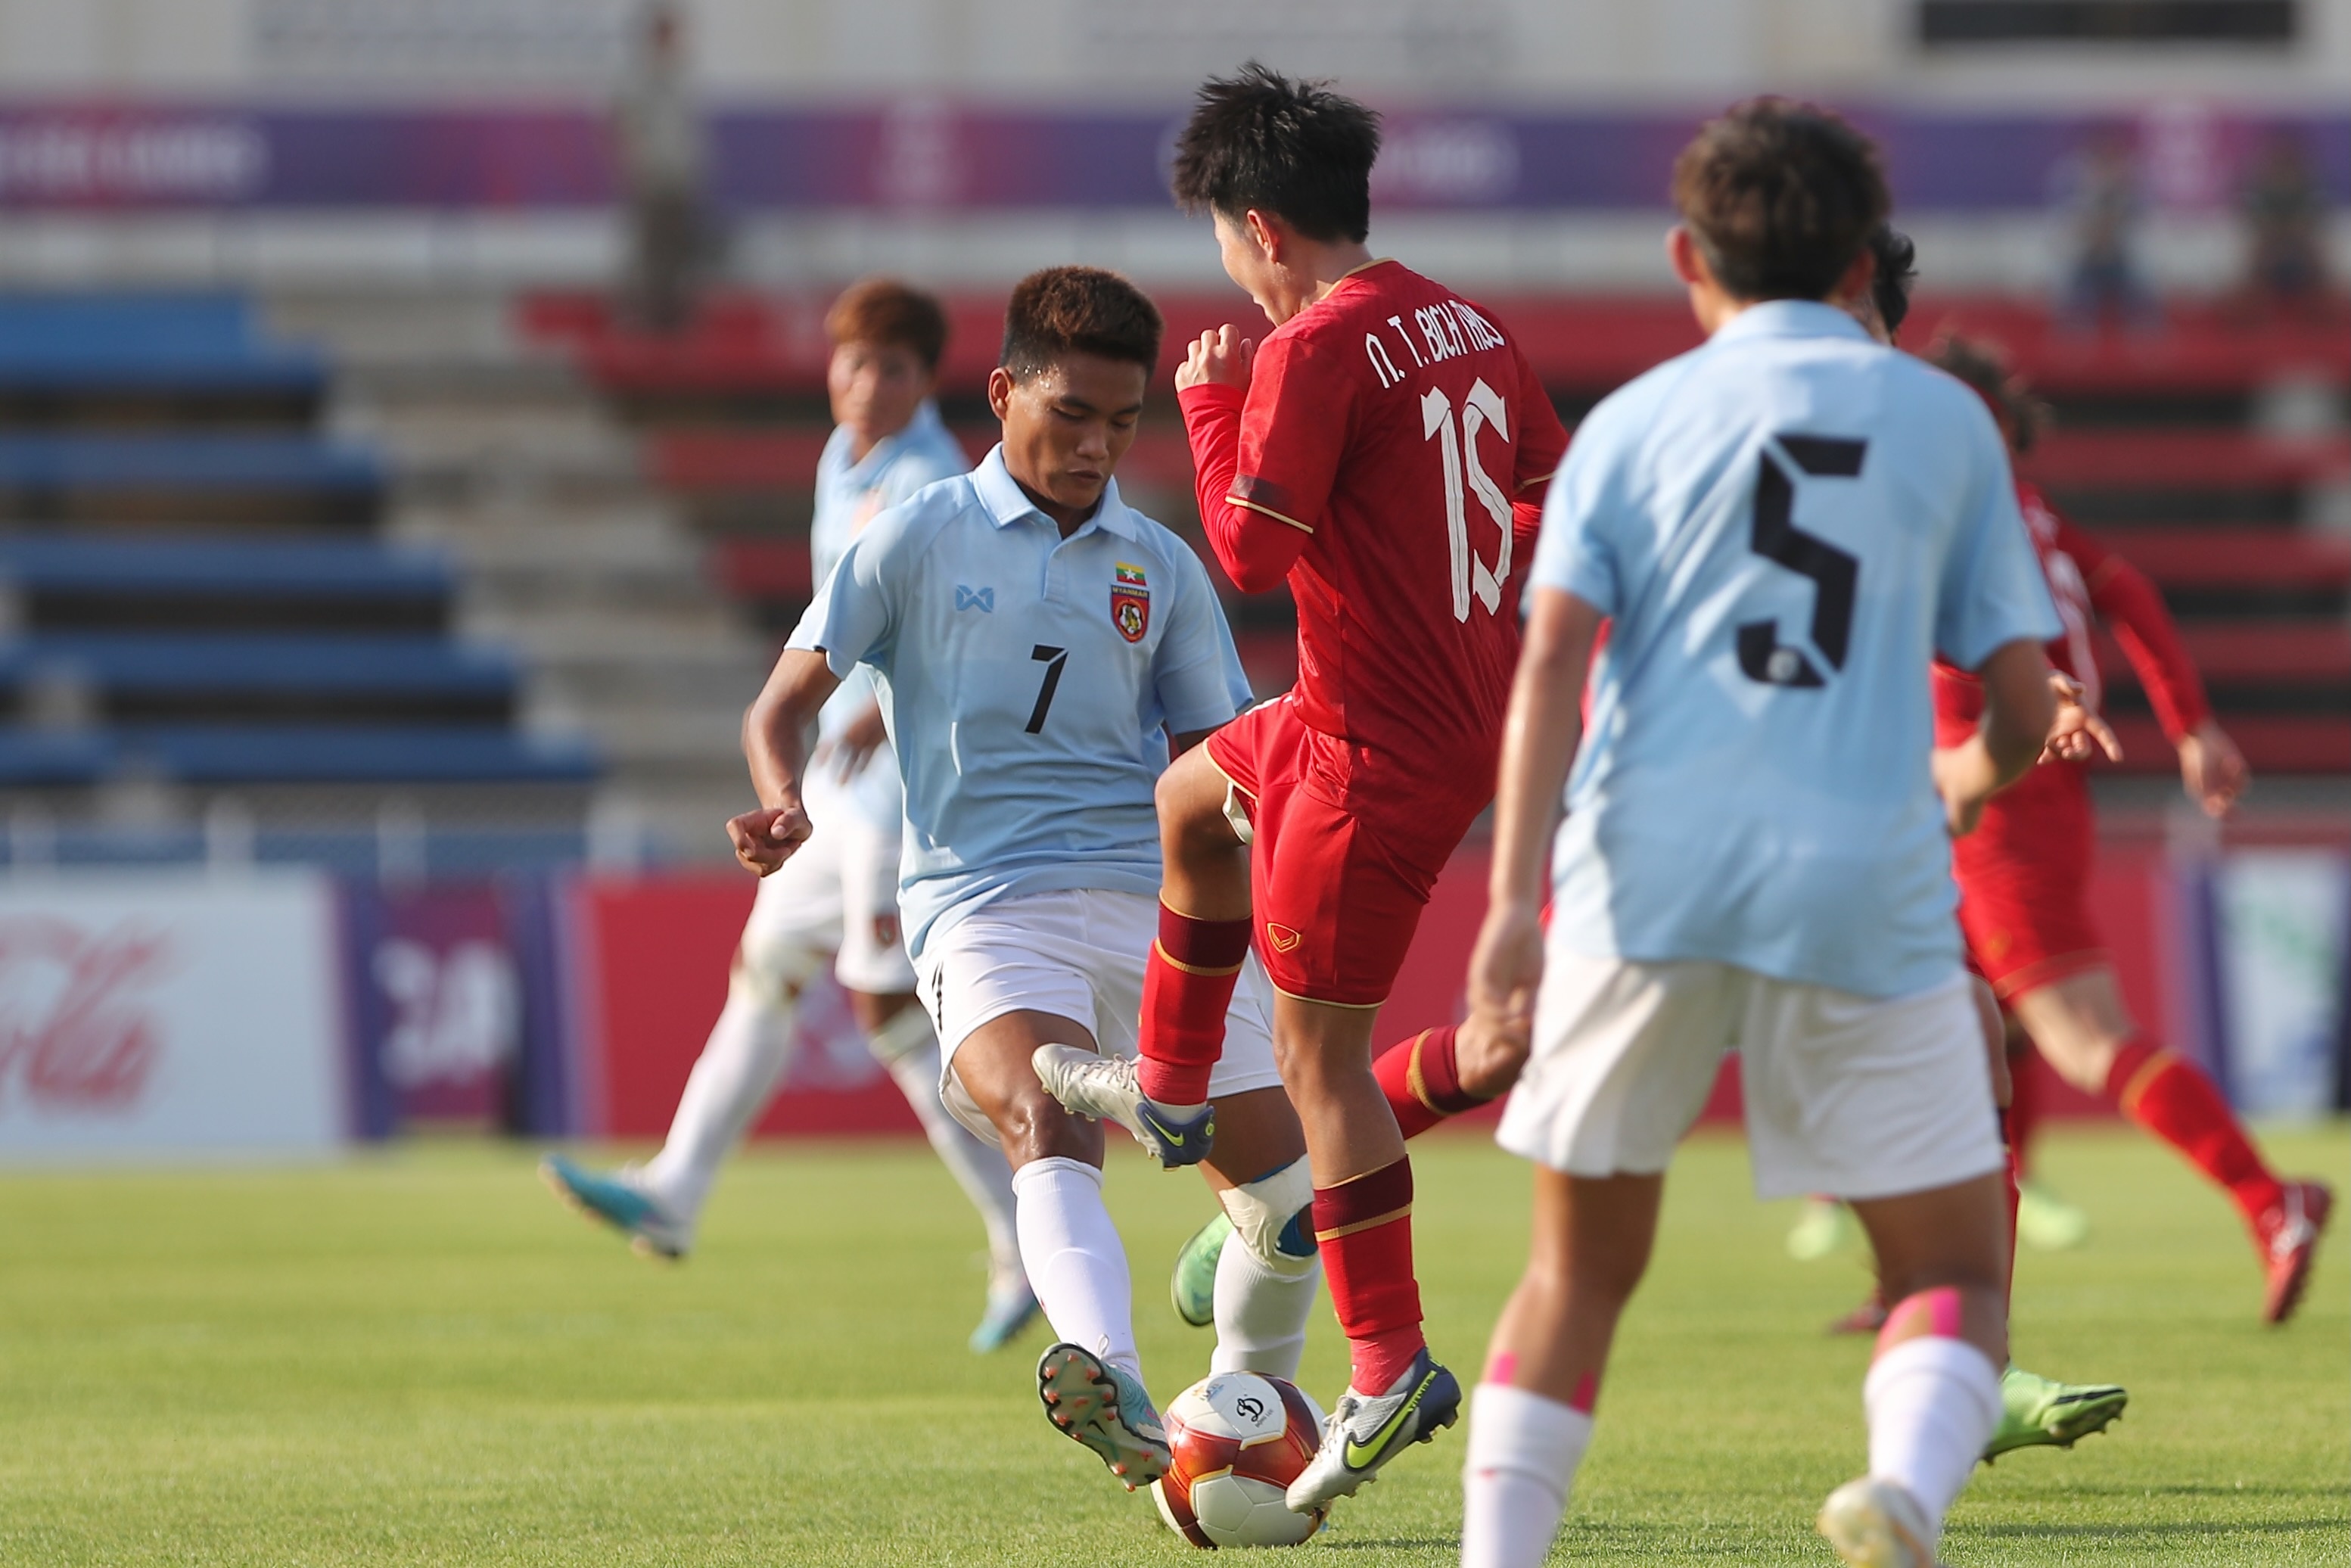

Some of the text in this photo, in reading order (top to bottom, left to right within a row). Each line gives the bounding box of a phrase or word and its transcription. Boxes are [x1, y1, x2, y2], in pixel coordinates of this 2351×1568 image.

[1386, 315, 1430, 368] T.
[1414, 302, 1469, 362] BICH
[1420, 376, 1513, 624] 15
[1735, 431, 1870, 689] 5
[1025, 644, 1068, 734] 7
